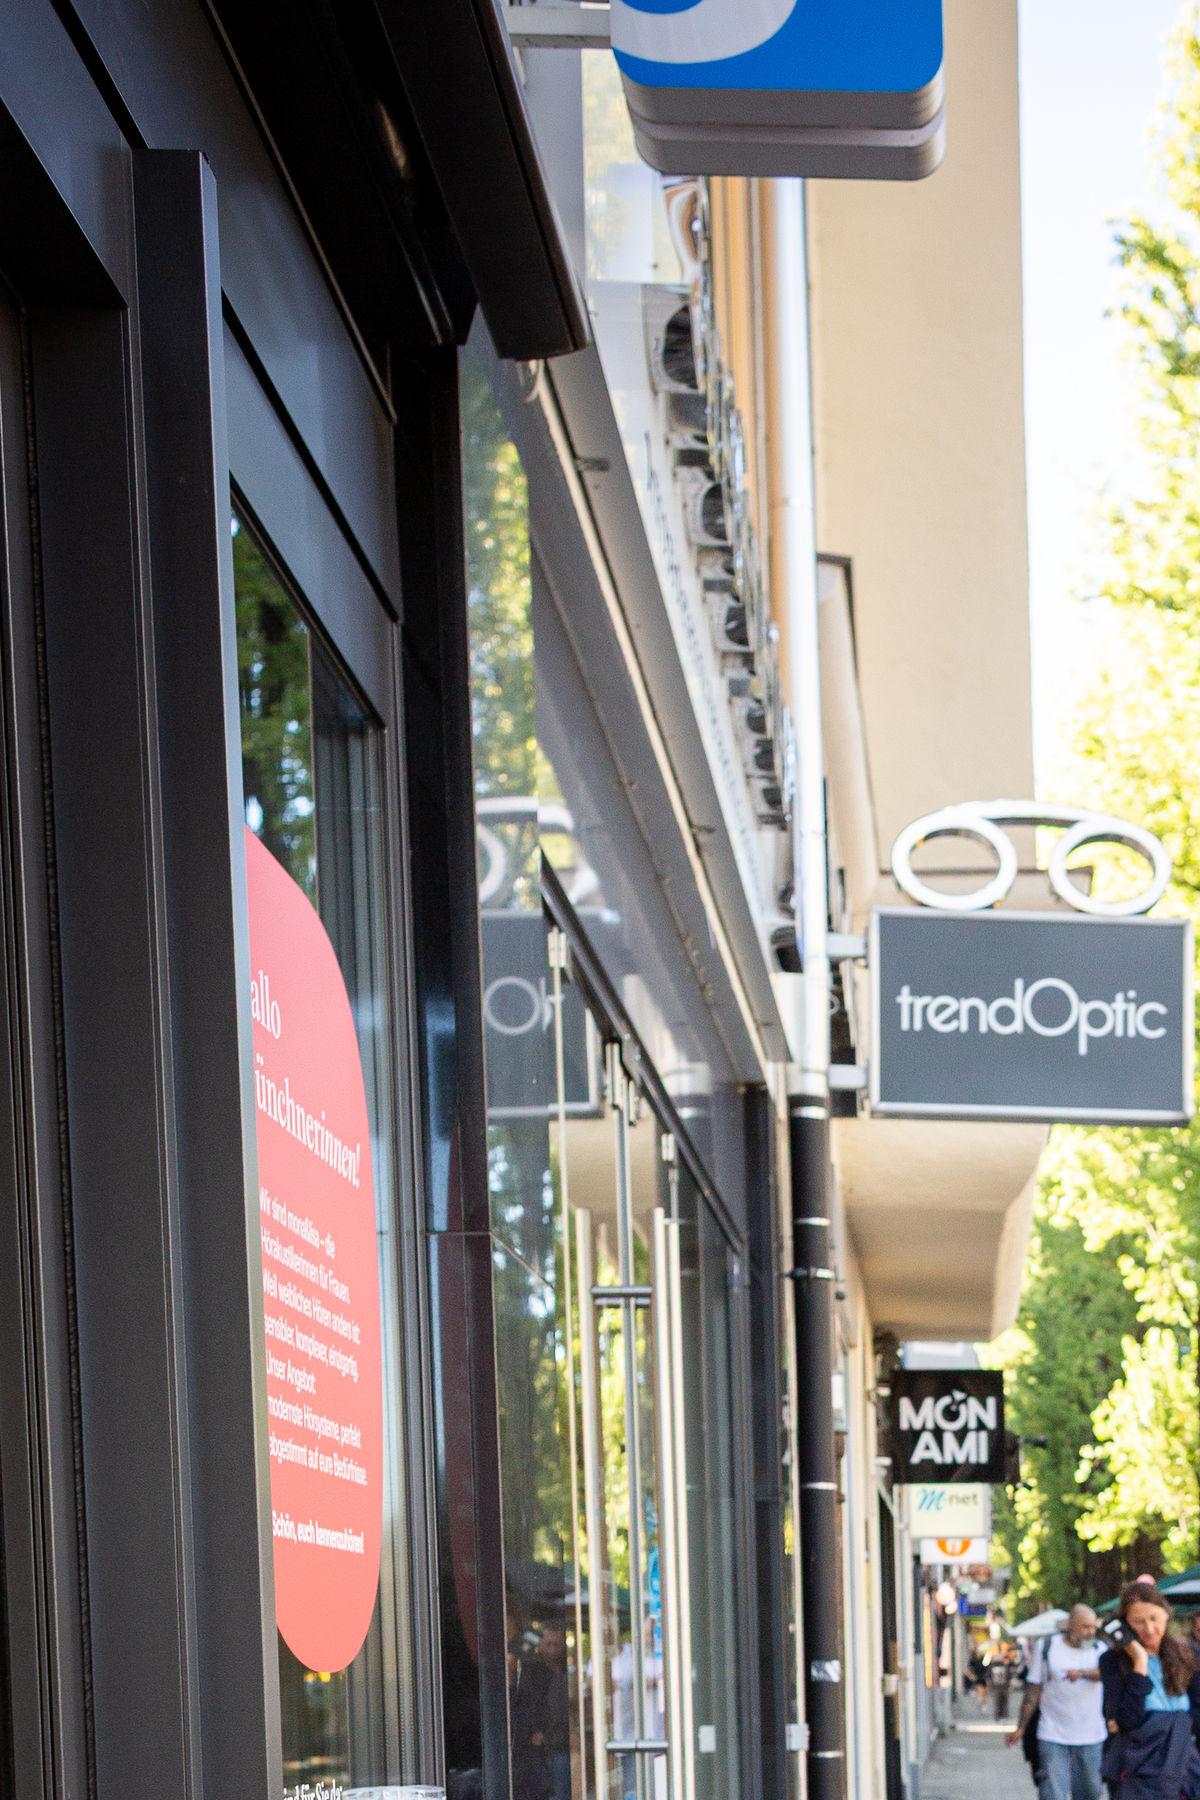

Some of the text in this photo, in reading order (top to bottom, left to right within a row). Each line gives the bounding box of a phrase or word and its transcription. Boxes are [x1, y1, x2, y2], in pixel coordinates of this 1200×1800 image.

[251, 970, 281, 1039] allo
[896, 977, 1168, 1056] trendOptic
[255, 1053, 360, 1188] ünchnerinnen!
[910, 1430, 988, 1464] AMI
[917, 1487, 979, 1511] M-net
